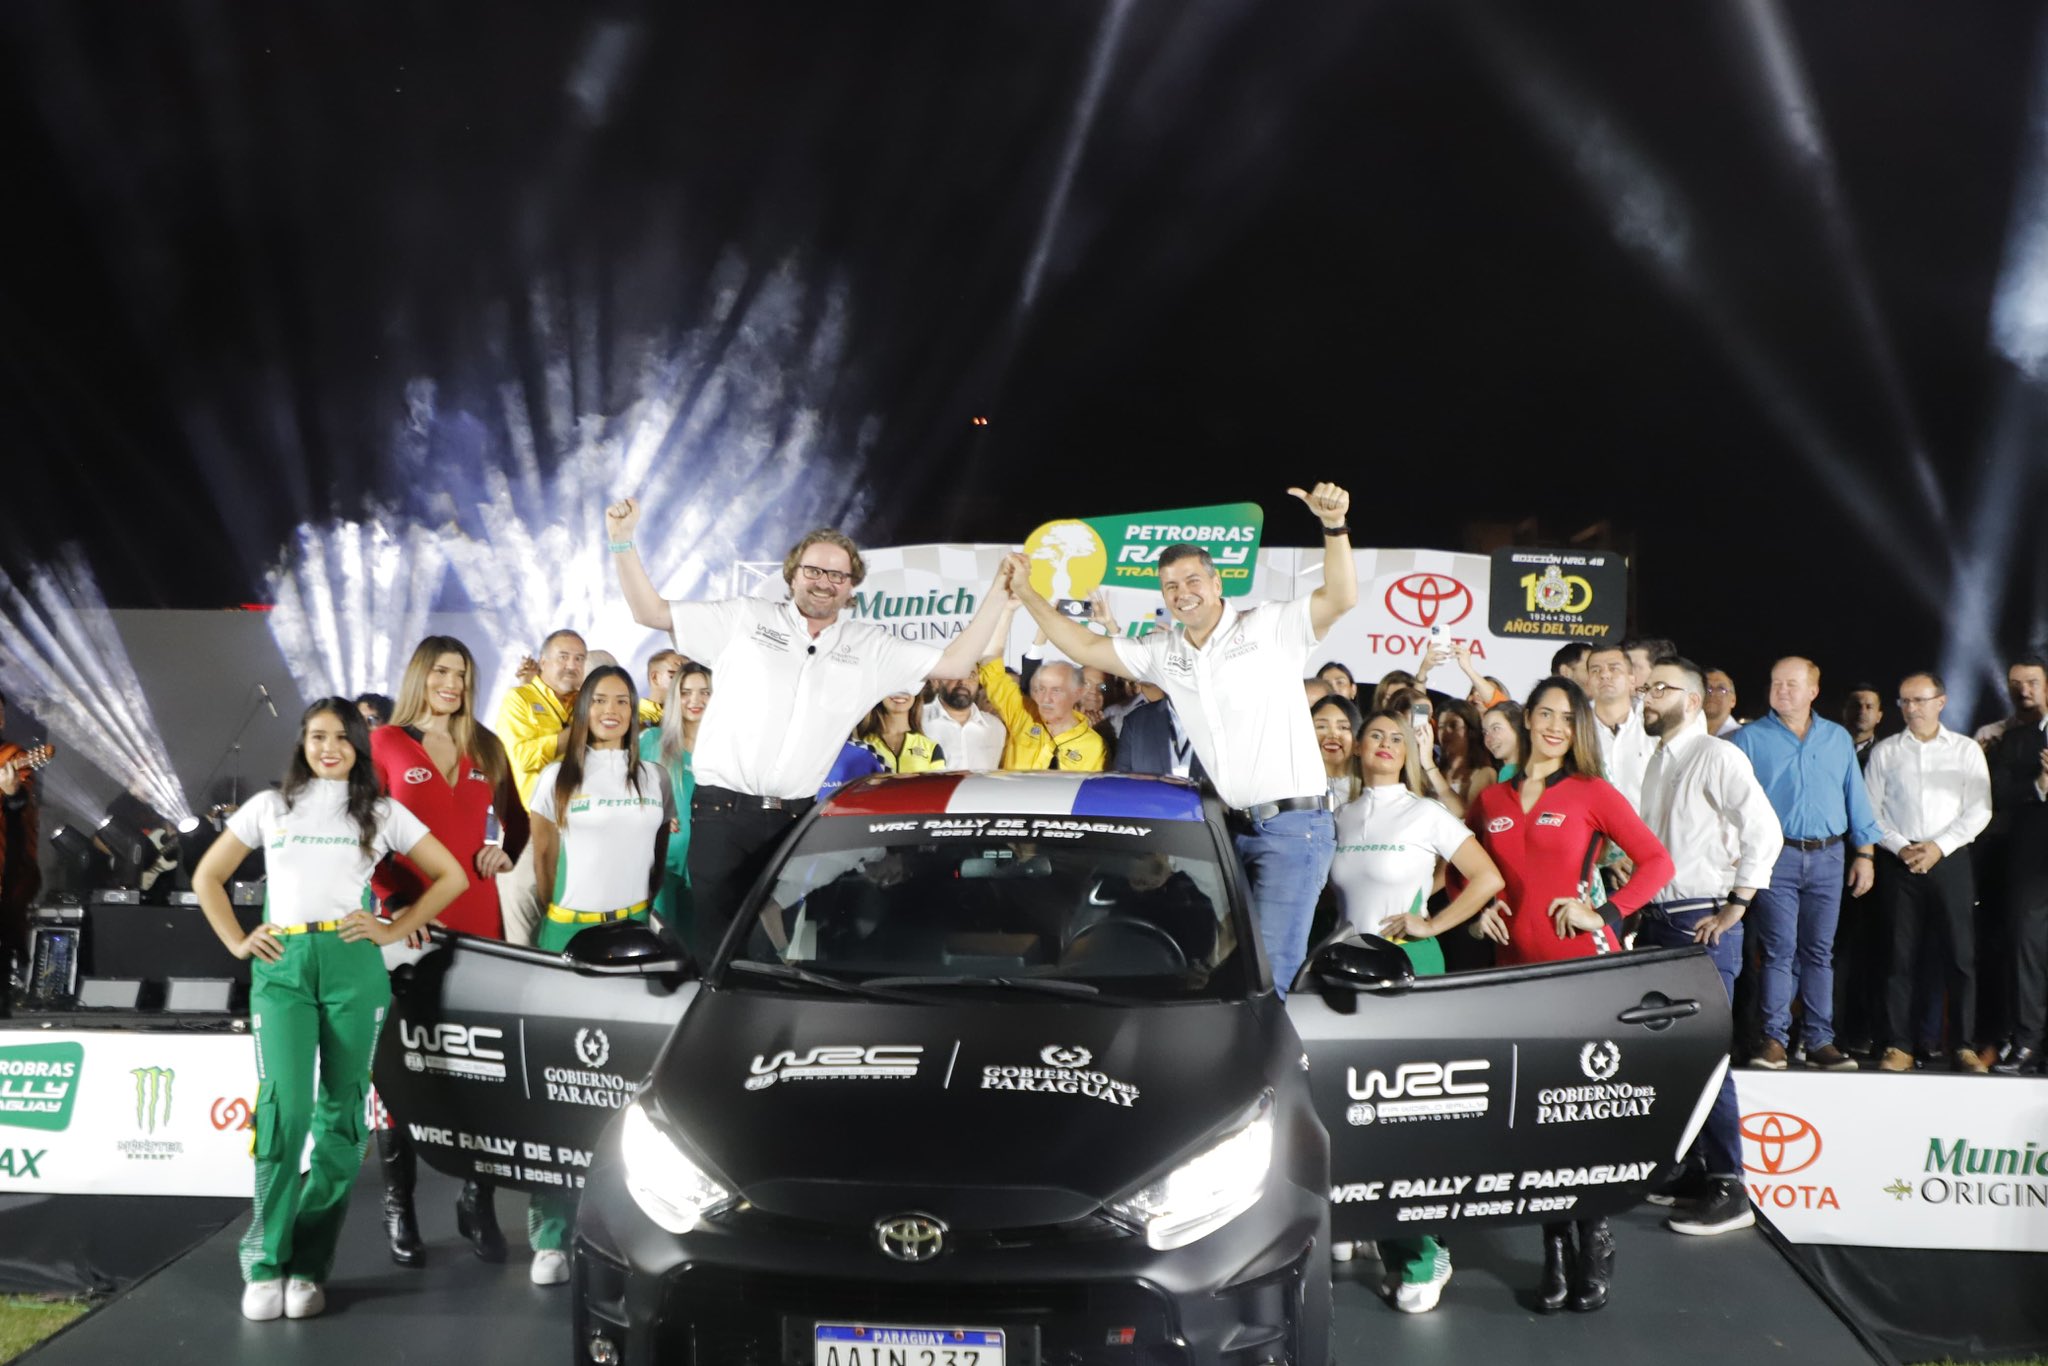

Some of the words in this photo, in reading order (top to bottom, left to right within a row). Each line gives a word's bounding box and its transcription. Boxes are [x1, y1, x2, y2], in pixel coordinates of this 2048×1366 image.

[1125, 525, 1255, 542] PETROBRAS
[851, 587, 976, 620] Munich
[1504, 619, 1540, 634] AÑOS
[1541, 621, 1566, 635] DEL
[1569, 623, 1609, 637] TACPY
[1530, 613, 1552, 621] 1924
[1560, 614, 1583, 622] 2024
[1368, 634, 1487, 659] TOYTA
[869, 821, 918, 833] WRC
[923, 819, 990, 830] RALLY
[995, 819, 1026, 829] DE
[1032, 820, 1152, 837] PARAGUAY
[1042, 831, 1084, 839] 2027
[292, 835, 359, 847] PETROBRA
[400, 1018, 504, 1061] WRC
[750, 1045, 924, 1075] WRC
[0, 1080, 69, 1099] LLY
[543, 1067, 624, 1091] GOBIERNO
[980, 1076, 1140, 1107] PARAGUAY
[983, 1065, 1108, 1085] GOBIERNO
[1109, 1078, 1141, 1095] DEL
[1347, 1059, 1490, 1100] WRC
[546, 1083, 631, 1109] PARAGUA
[1538, 1082, 1633, 1105] GOBIERNO
[1633, 1085, 1656, 1098] DEL
[1347, 1102, 1376, 1126] FIA
[1380, 1111, 1484, 1124] CHAMPIONSHIP
[1537, 1097, 1656, 1124] PARAGUAY
[408, 1122, 454, 1147] WRC
[458, 1131, 518, 1157] RALLY
[522, 1141, 552, 1162] DE
[474, 1160, 512, 1178] 2025
[524, 1167, 563, 1185] 2026
[1330, 1181, 1384, 1204] WRC
[1389, 1175, 1472, 1200] RALLY
[1475, 1172, 1515, 1194] DE
[1519, 1161, 1657, 1191] PARAGUAY
[1397, 1203, 1449, 1222] 2025
[1463, 1199, 1514, 1217] 2026
[1528, 1195, 1578, 1212] 2027
[1744, 1183, 1840, 1210] YOTA
[873, 1330, 945, 1345] PARAGUAY
